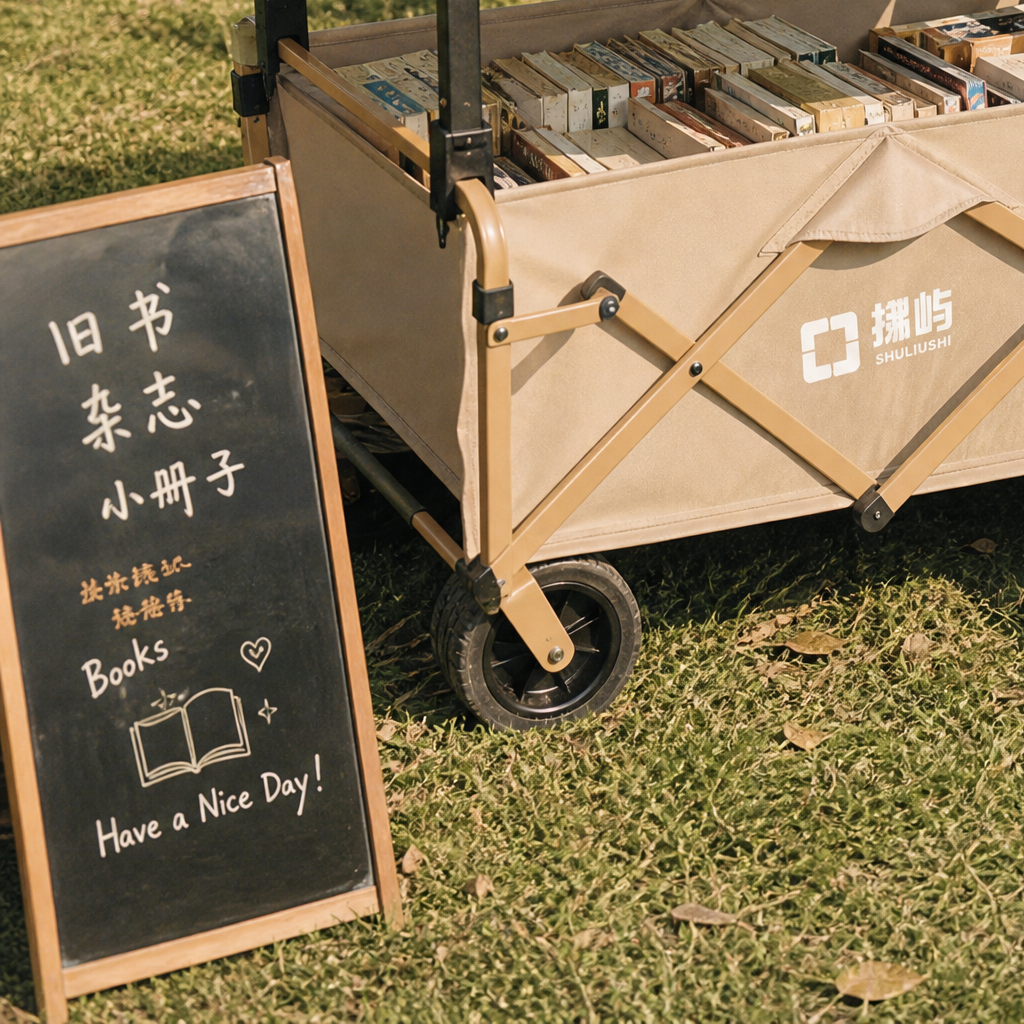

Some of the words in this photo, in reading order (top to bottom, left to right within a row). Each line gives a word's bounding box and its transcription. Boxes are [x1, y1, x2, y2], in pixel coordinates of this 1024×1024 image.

[48, 281, 174, 366] 旧书
[875, 334, 952, 365] SHULIUSHI
[81, 370, 202, 453] 杂志
[101, 449, 245, 521] 小册子
[81, 638, 170, 699] Books
[95, 816, 162, 858] Have
[172, 812, 190, 831] a
[198, 787, 254, 823] Nice
[260, 753, 323, 816] Day!
